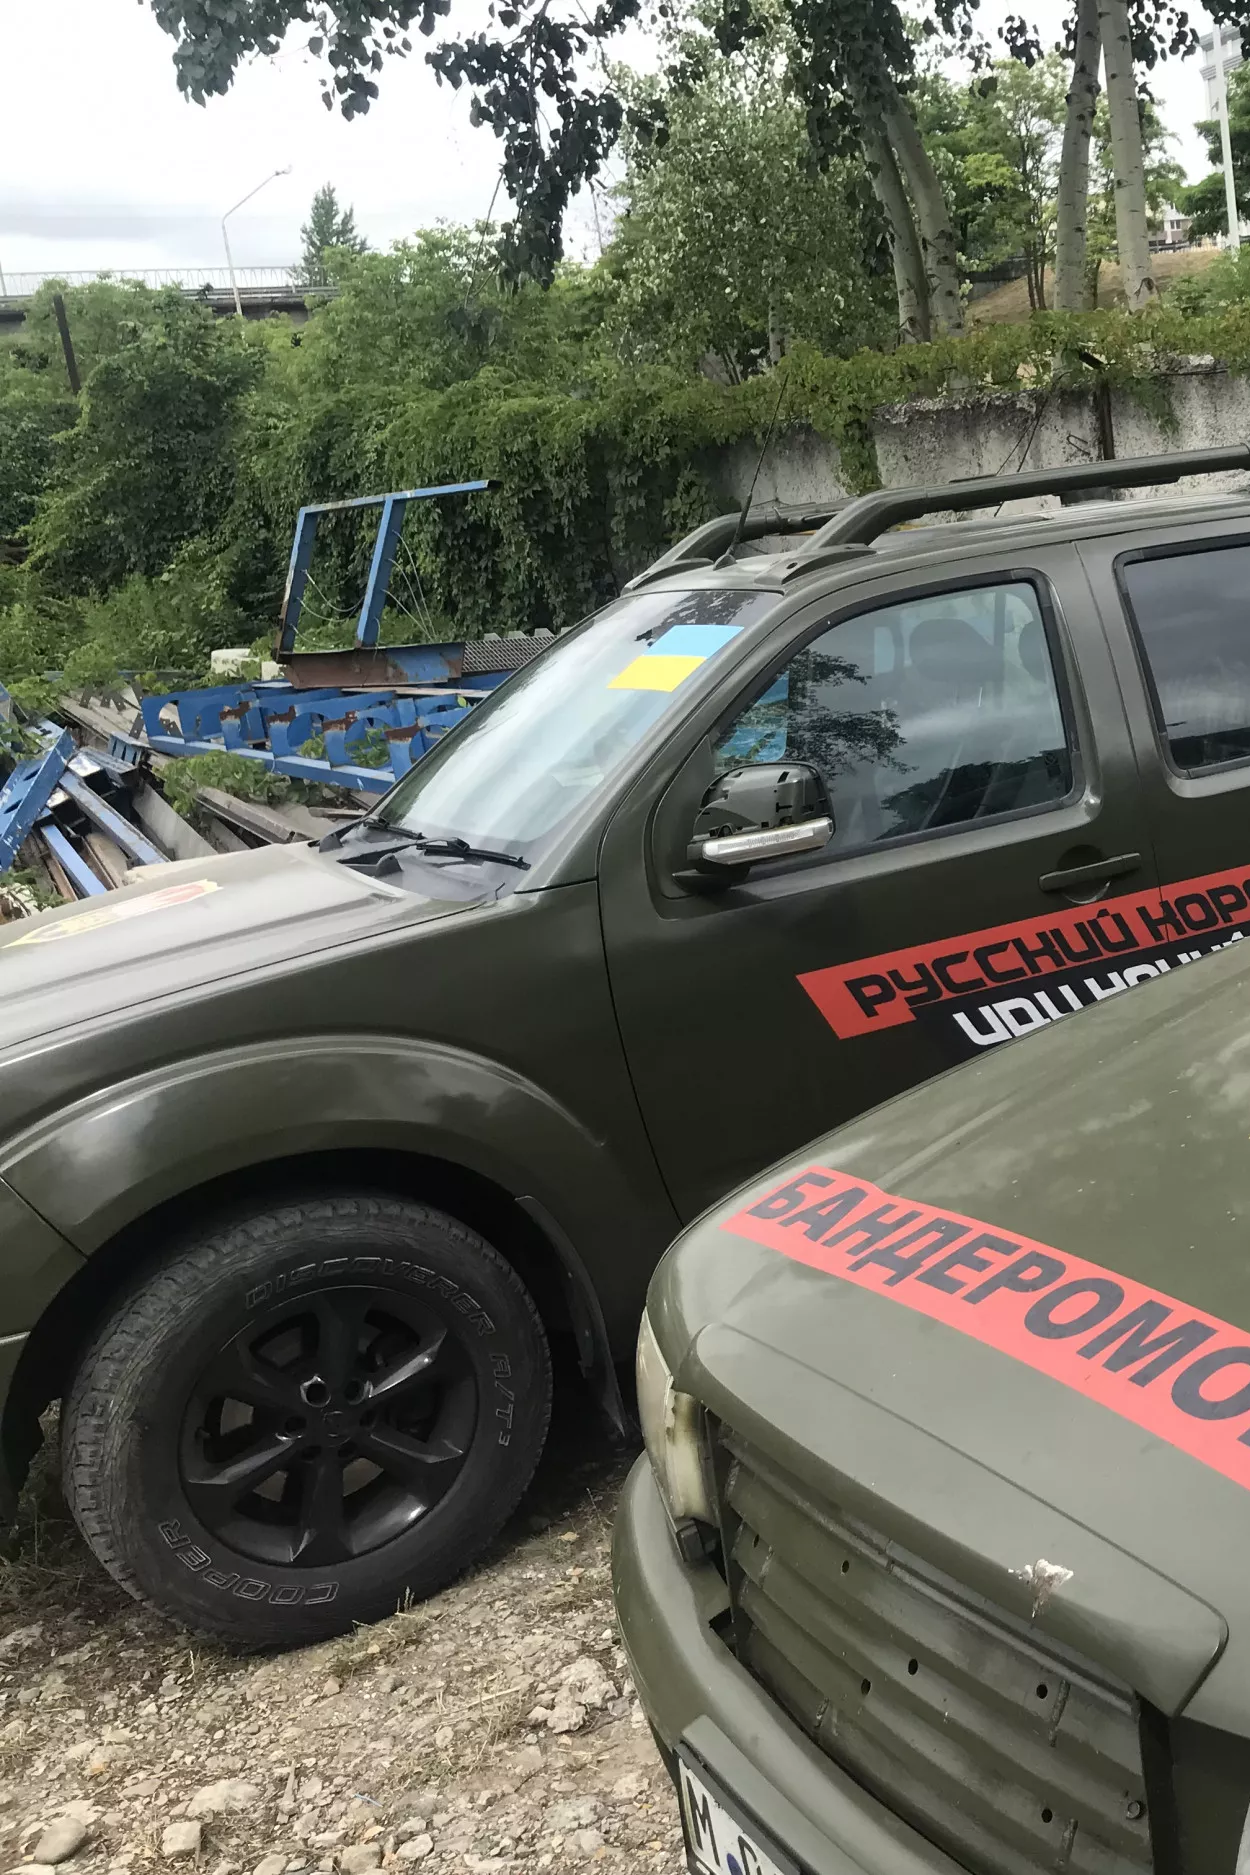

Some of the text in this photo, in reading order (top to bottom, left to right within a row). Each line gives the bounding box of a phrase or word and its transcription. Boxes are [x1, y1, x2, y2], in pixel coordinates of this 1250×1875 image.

[844, 908, 1139, 1018] РУССКИЙ
[244, 1256, 497, 1338] DISCOVERER
[156, 1517, 340, 1606] COOPER
